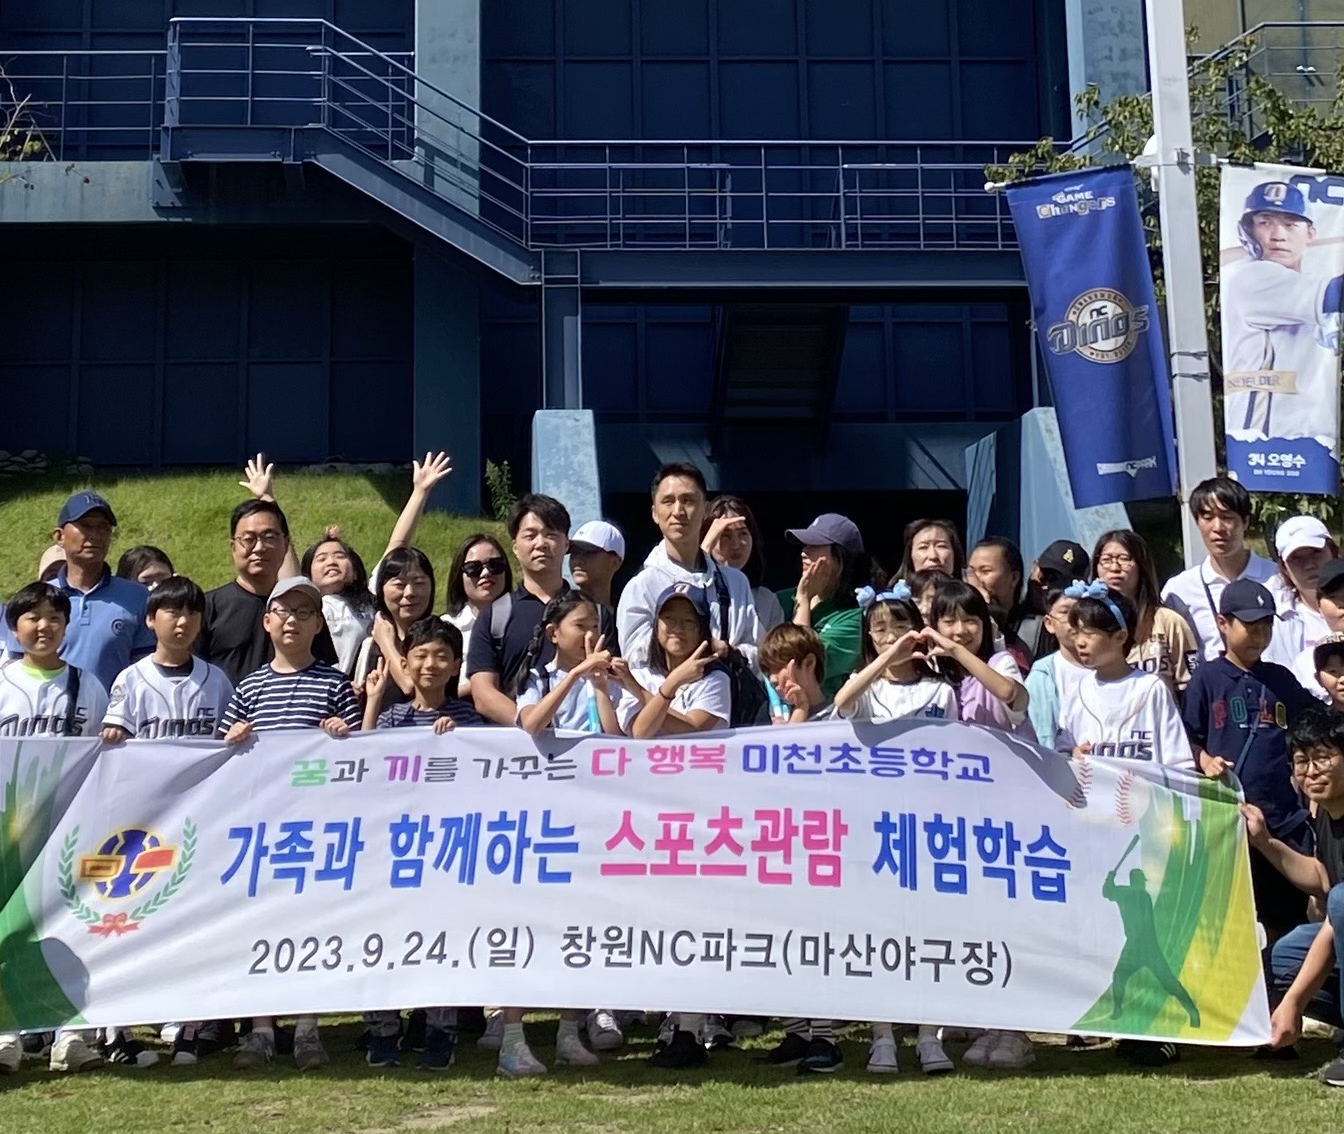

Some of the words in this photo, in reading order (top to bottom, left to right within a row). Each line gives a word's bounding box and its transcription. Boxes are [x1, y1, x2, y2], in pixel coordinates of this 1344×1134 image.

[1055, 191, 1093, 203] GAME
[1248, 453, 1265, 466] 34
[1267, 453, 1306, 469] 오영수
[291, 758, 369, 787] 꿈과
[384, 756, 458, 782] 끼를
[472, 755, 577, 781] 가꾸는
[591, 747, 632, 777] 다
[646, 743, 727, 775] 행복
[742, 742, 995, 784] 미천초등학교
[220, 817, 365, 897] 가족과
[389, 810, 579, 888] 함께하는
[600, 806, 848, 888] 스포츠관람
[872, 810, 1072, 903] 체험학습
[560, 925, 1012, 988] 창원NC파크(마산야구장)
